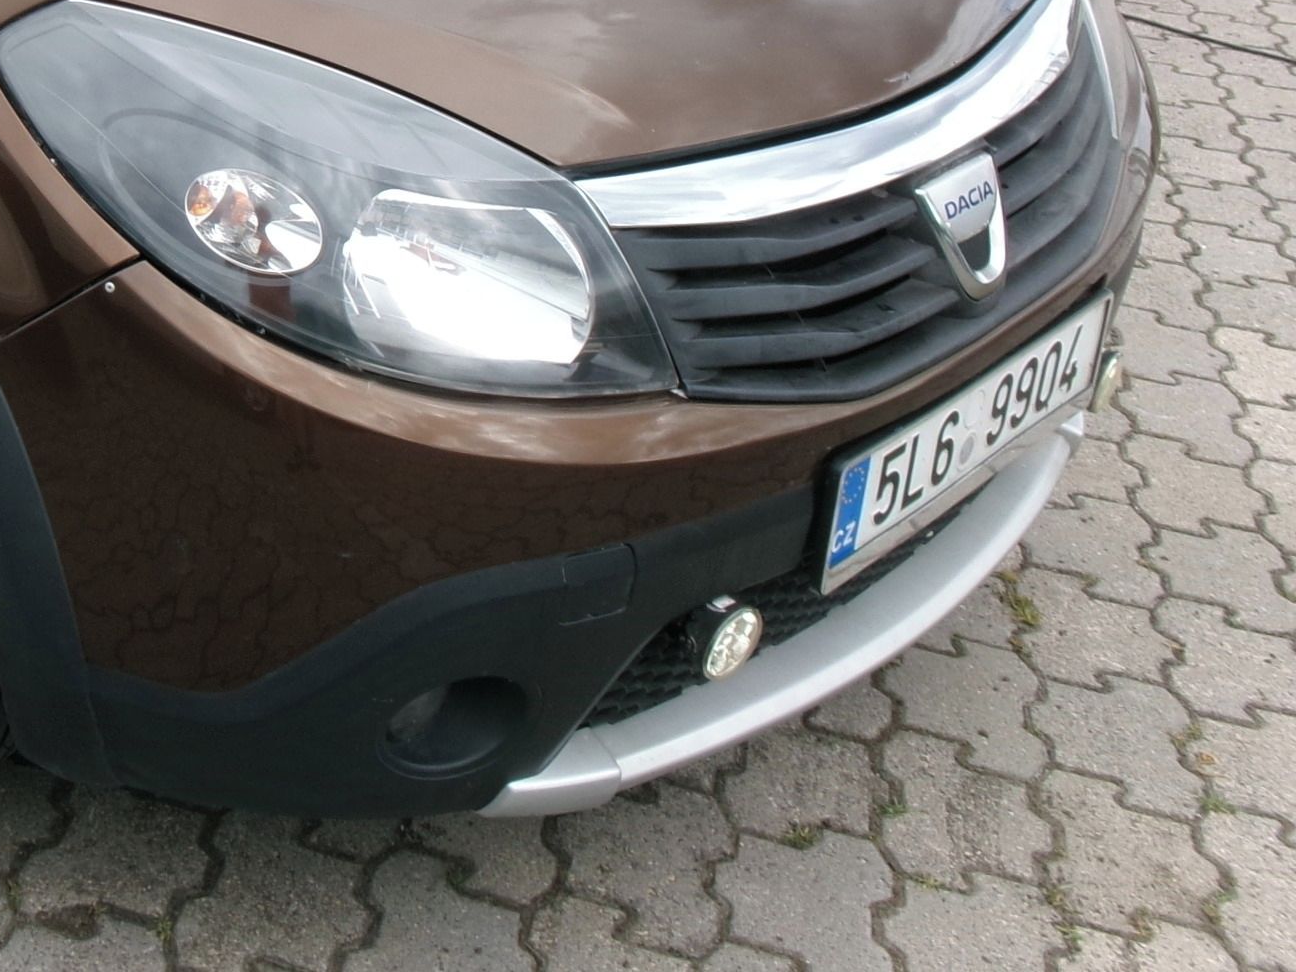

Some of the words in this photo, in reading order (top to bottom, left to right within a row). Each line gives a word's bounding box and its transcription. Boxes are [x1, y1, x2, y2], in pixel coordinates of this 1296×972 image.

[944, 181, 993, 219] DACIA
[873, 409, 960, 526] 5L6
[986, 324, 1084, 447] 9904
[831, 520, 856, 554] CZ
